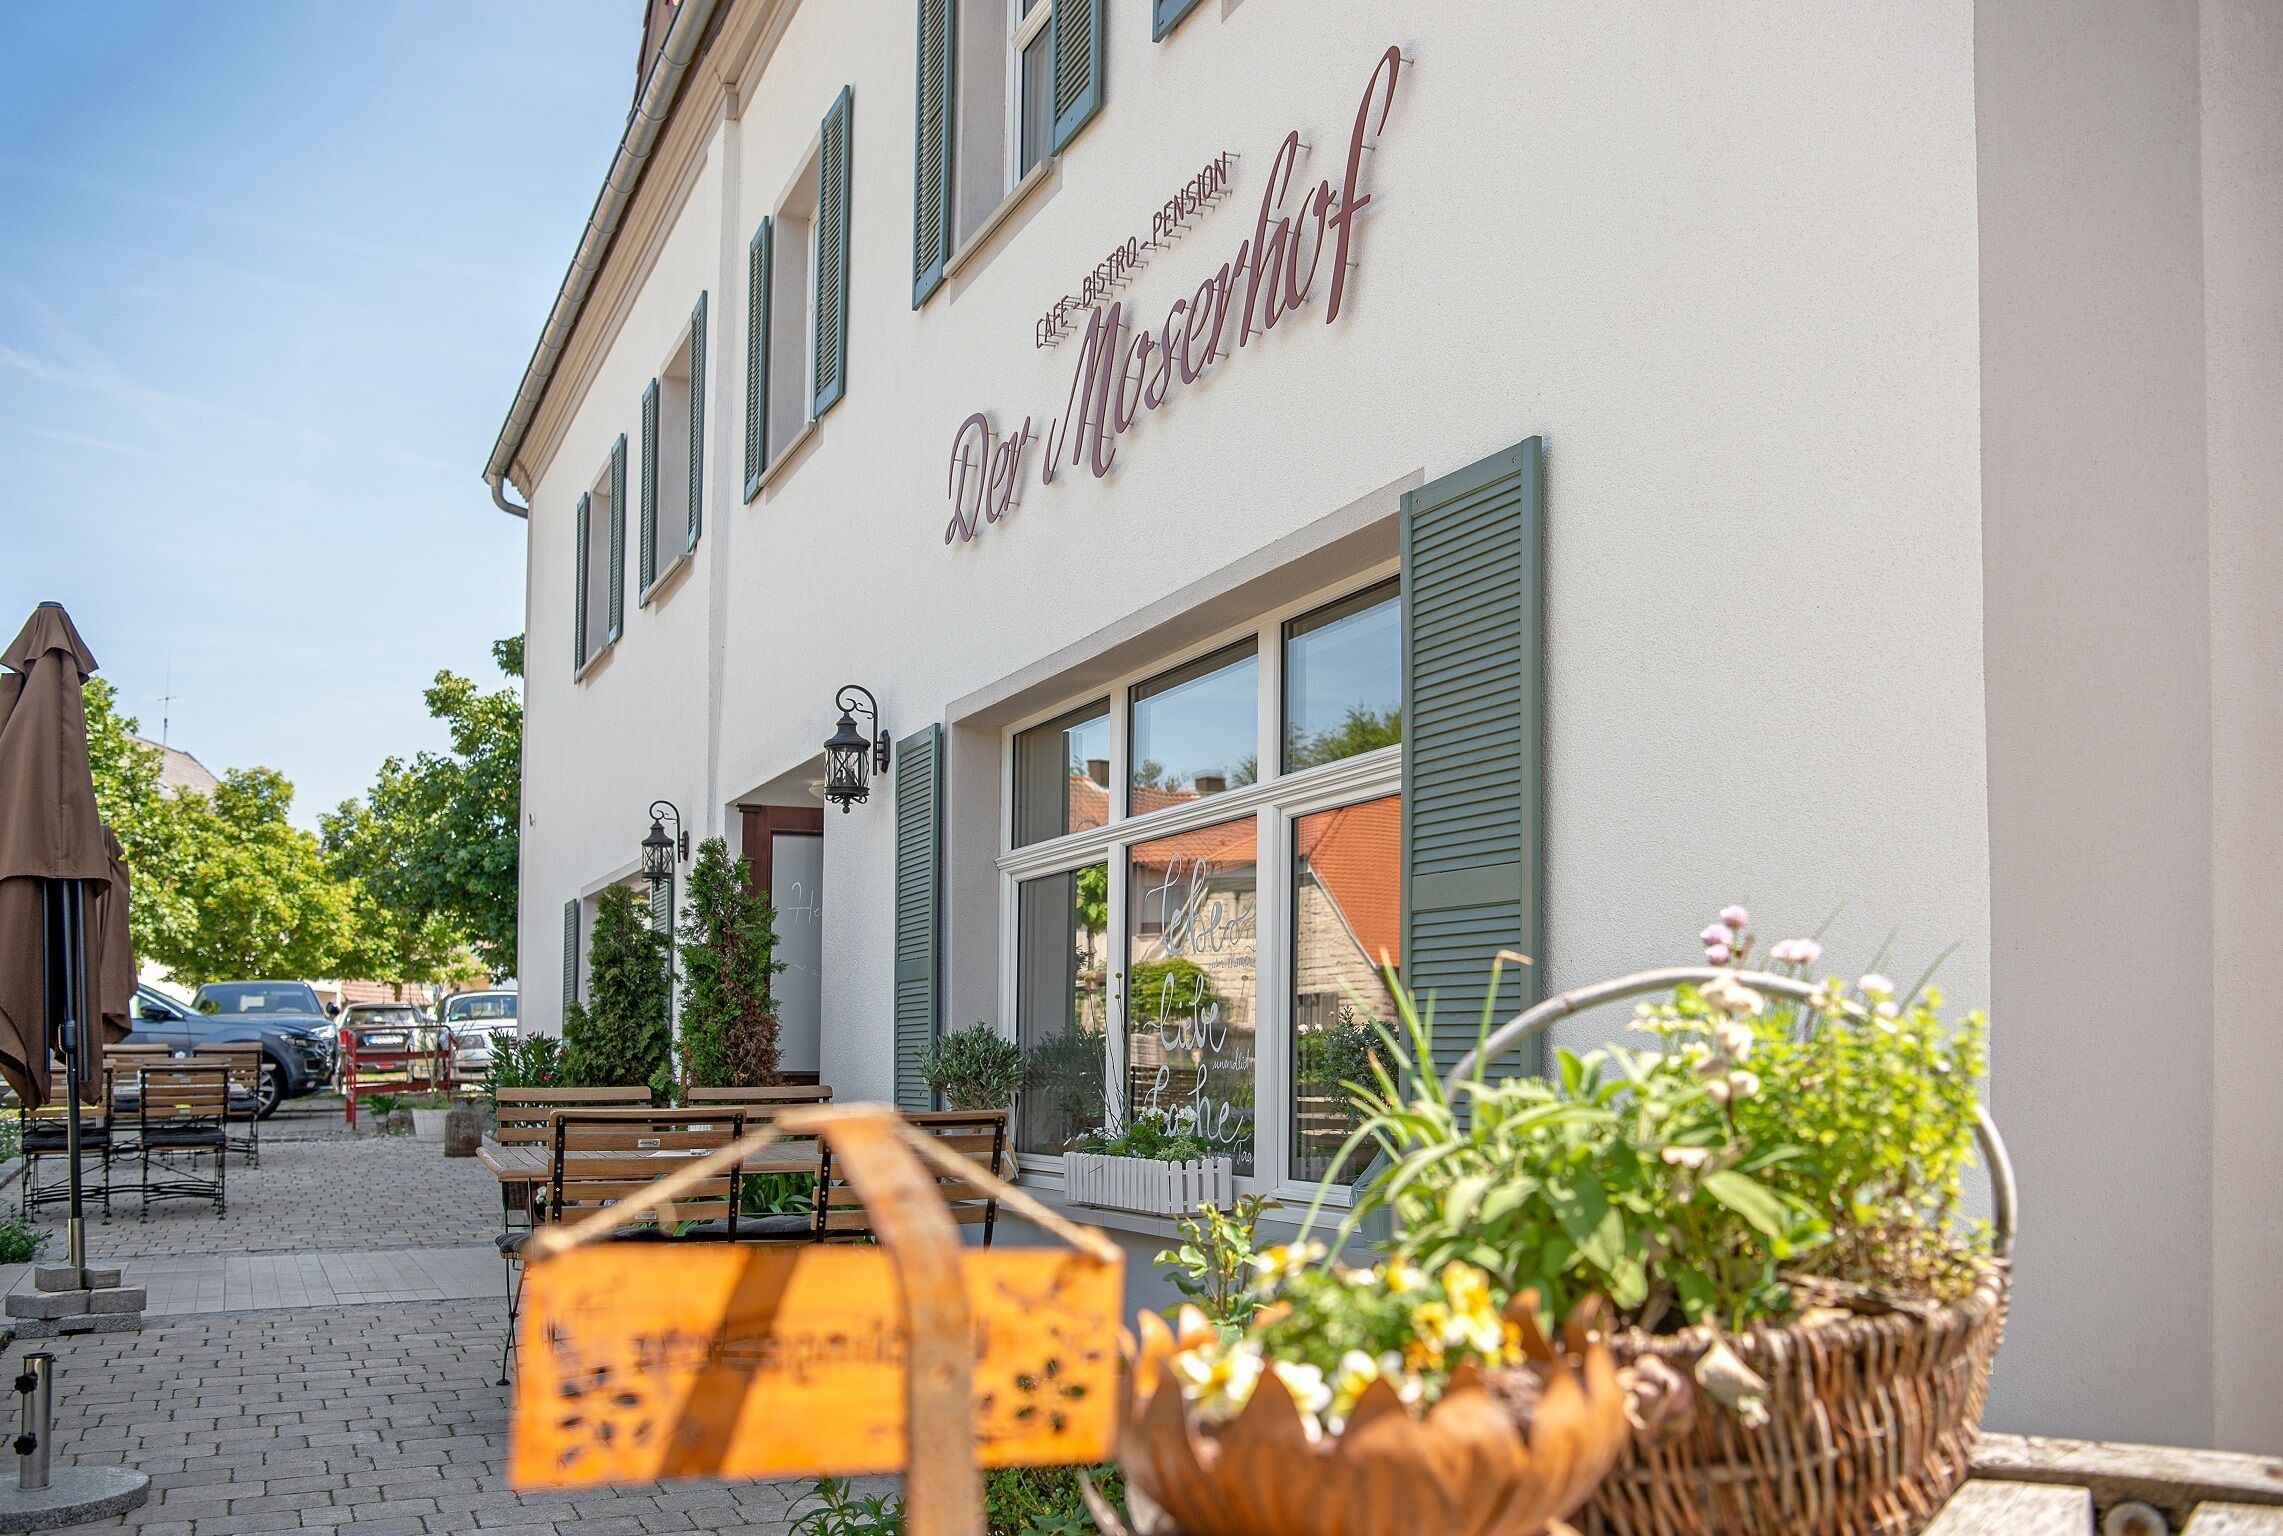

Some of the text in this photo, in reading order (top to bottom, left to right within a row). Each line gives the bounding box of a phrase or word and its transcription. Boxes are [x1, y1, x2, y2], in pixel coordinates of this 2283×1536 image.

[945, 45, 1401, 545] Der Moserhof
[1083, 236, 1137, 308] BISTRO
[1153, 151, 1227, 247] PENSION
